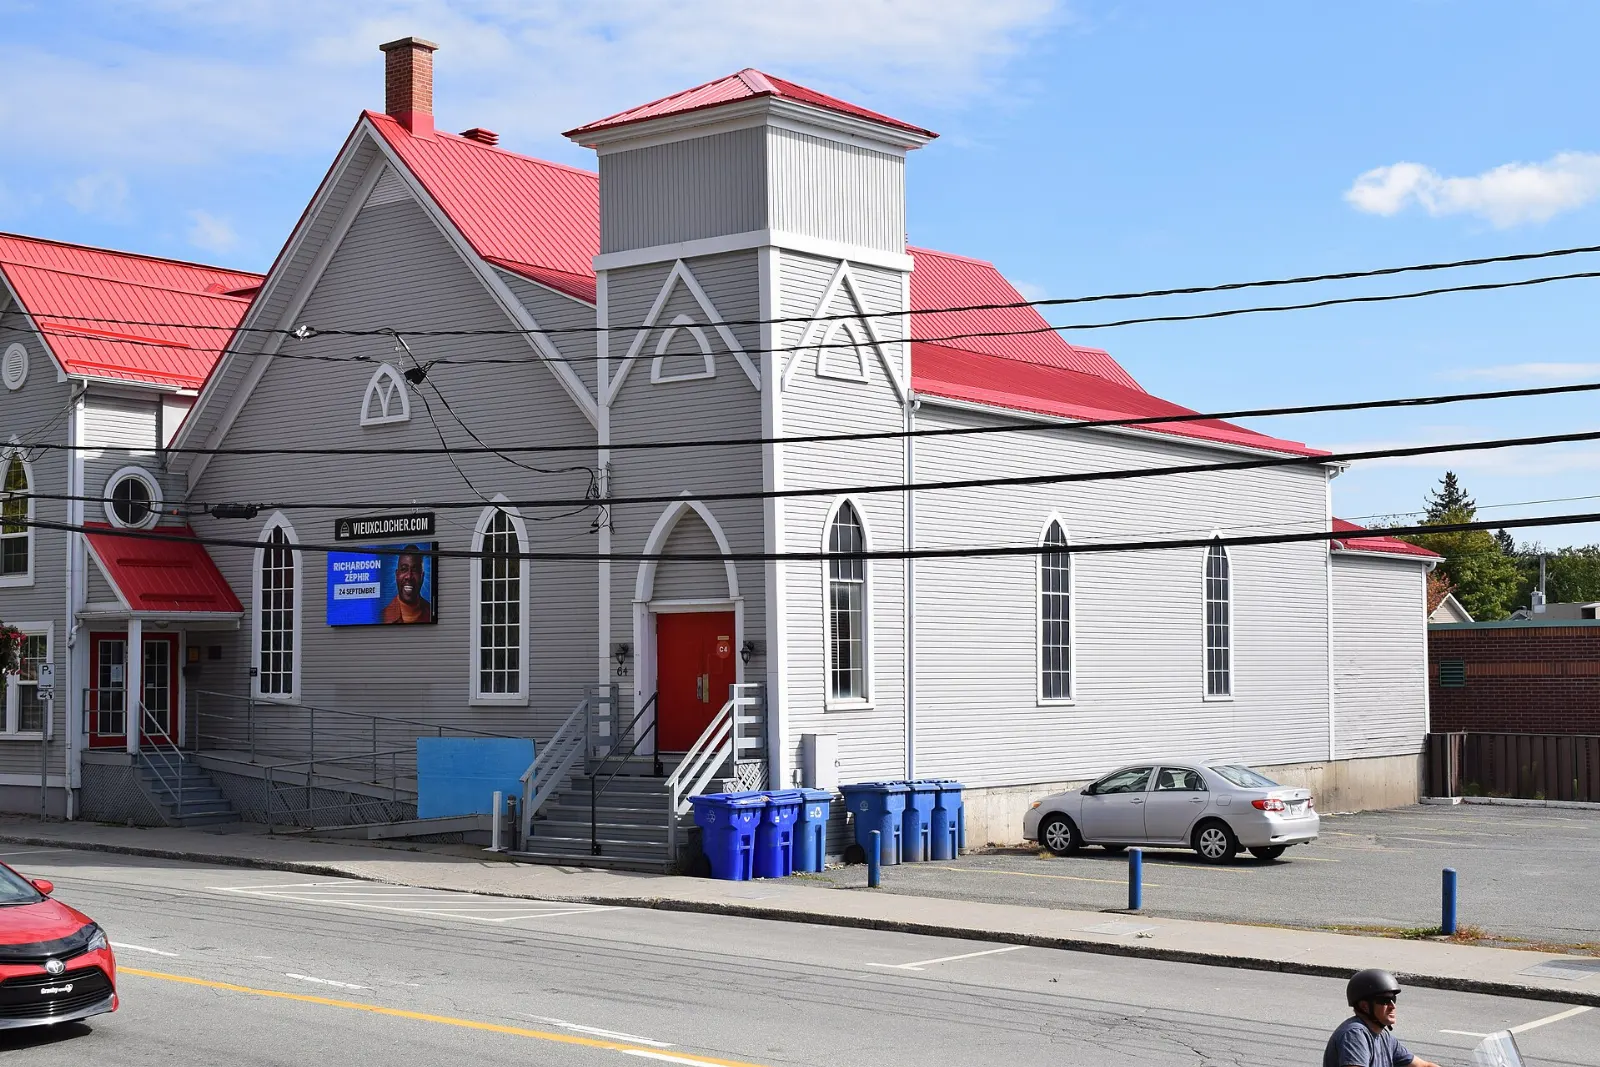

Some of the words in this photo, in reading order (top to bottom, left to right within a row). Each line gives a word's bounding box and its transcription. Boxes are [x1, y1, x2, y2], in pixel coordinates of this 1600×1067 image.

[352, 518, 428, 535] VIEUXCLOCHER.COM
[333, 560, 381, 571] RICHARDSON
[344, 571, 370, 582] ZÉPHIR
[346, 587, 376, 595] SEPTEMBRE
[616, 666, 628, 676] 64
